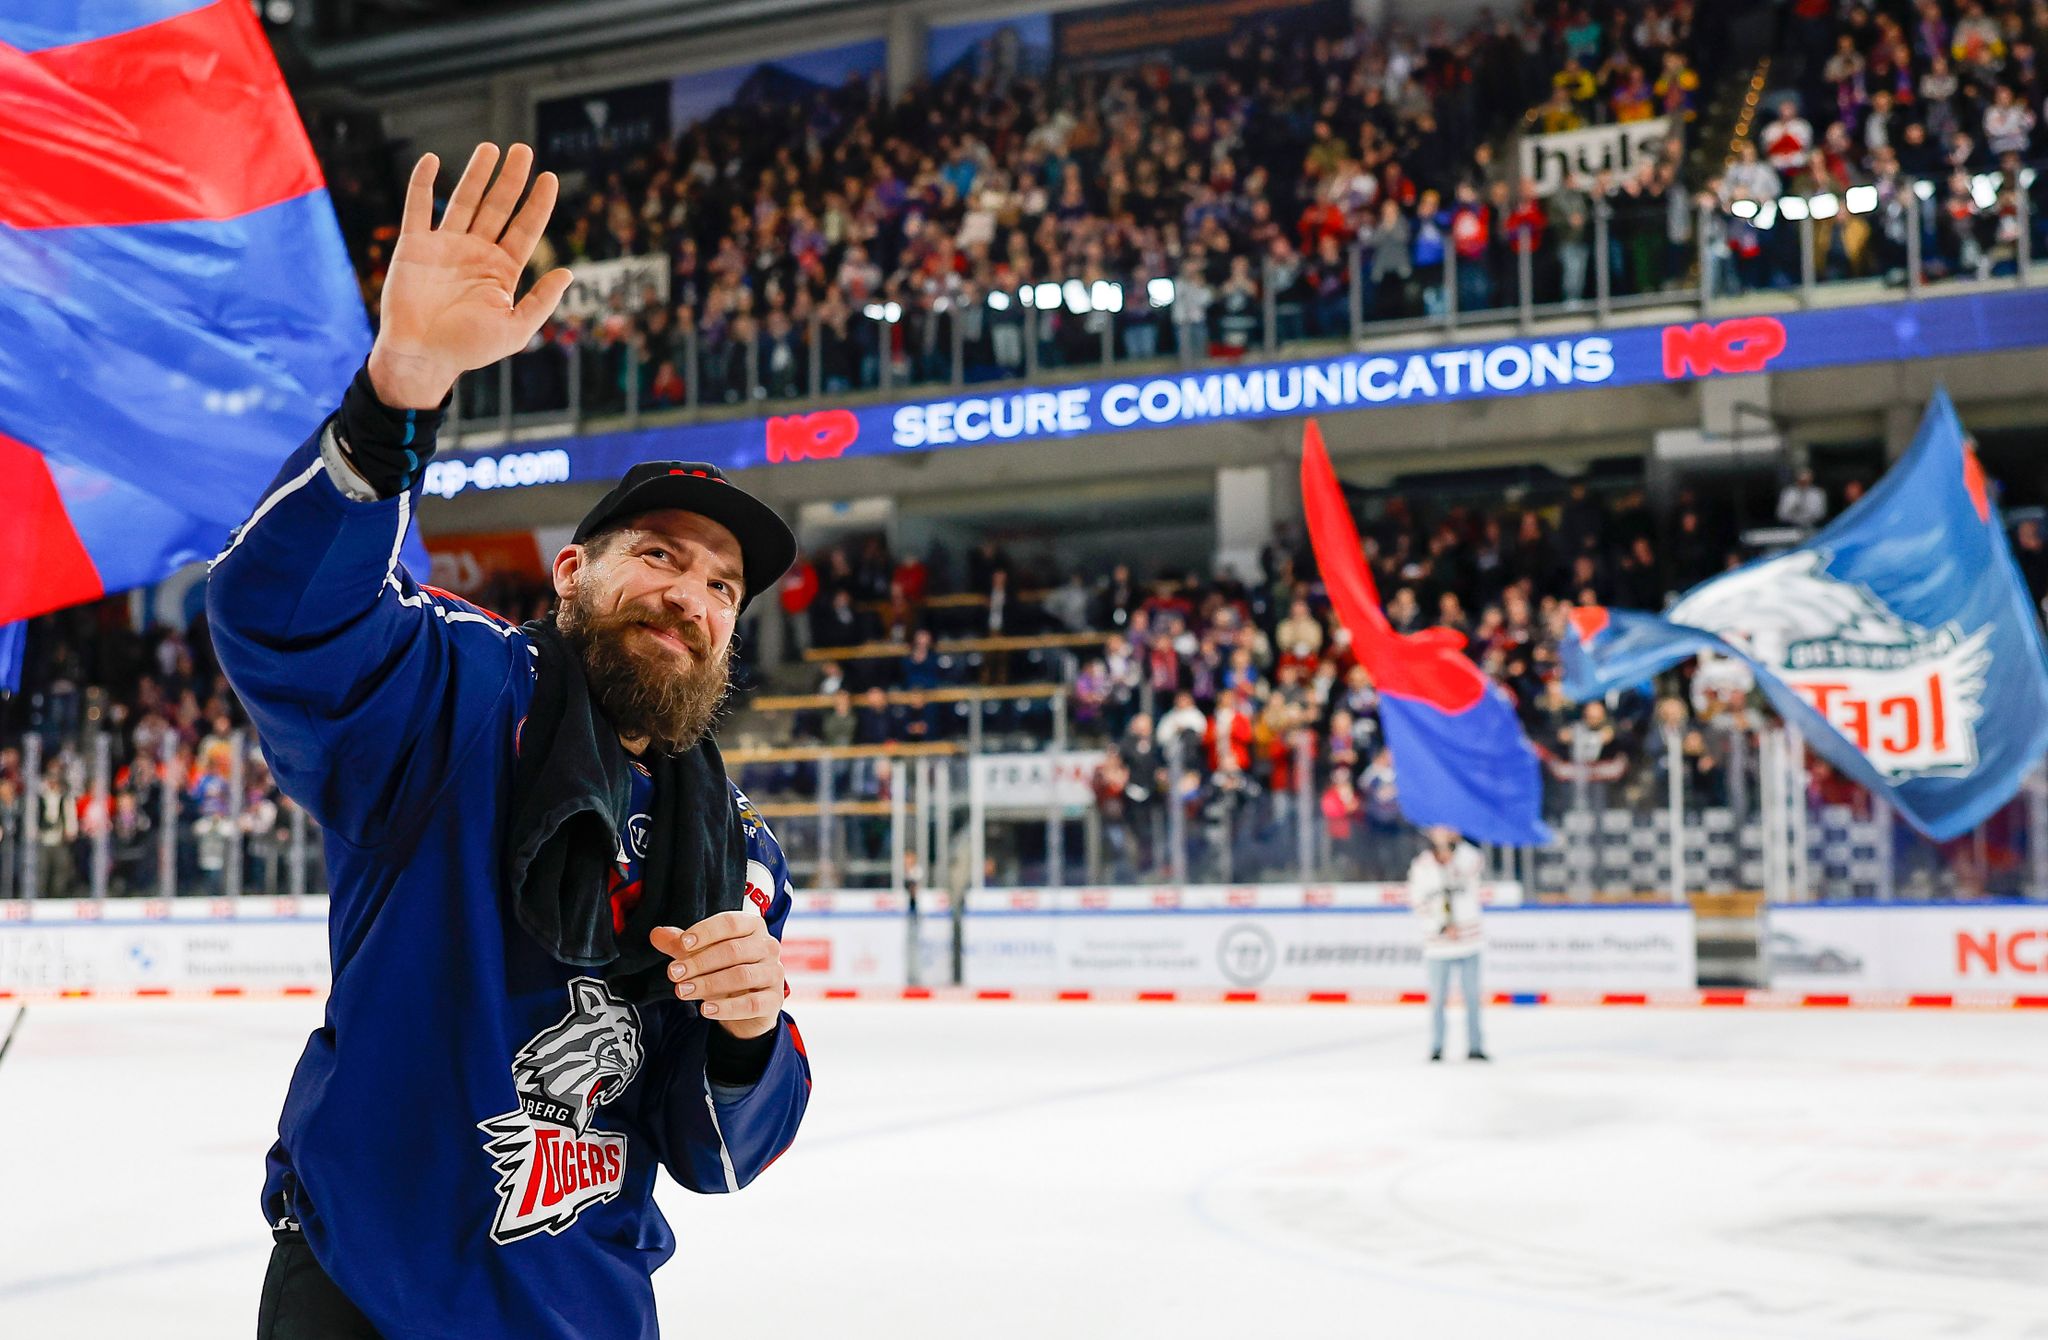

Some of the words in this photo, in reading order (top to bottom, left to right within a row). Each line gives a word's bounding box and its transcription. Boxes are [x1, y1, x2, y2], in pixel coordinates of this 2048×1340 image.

[893, 390, 1092, 447] SECURE
[1101, 337, 1614, 426] COMMUNICATIONS
[1956, 930, 2048, 974] NC
